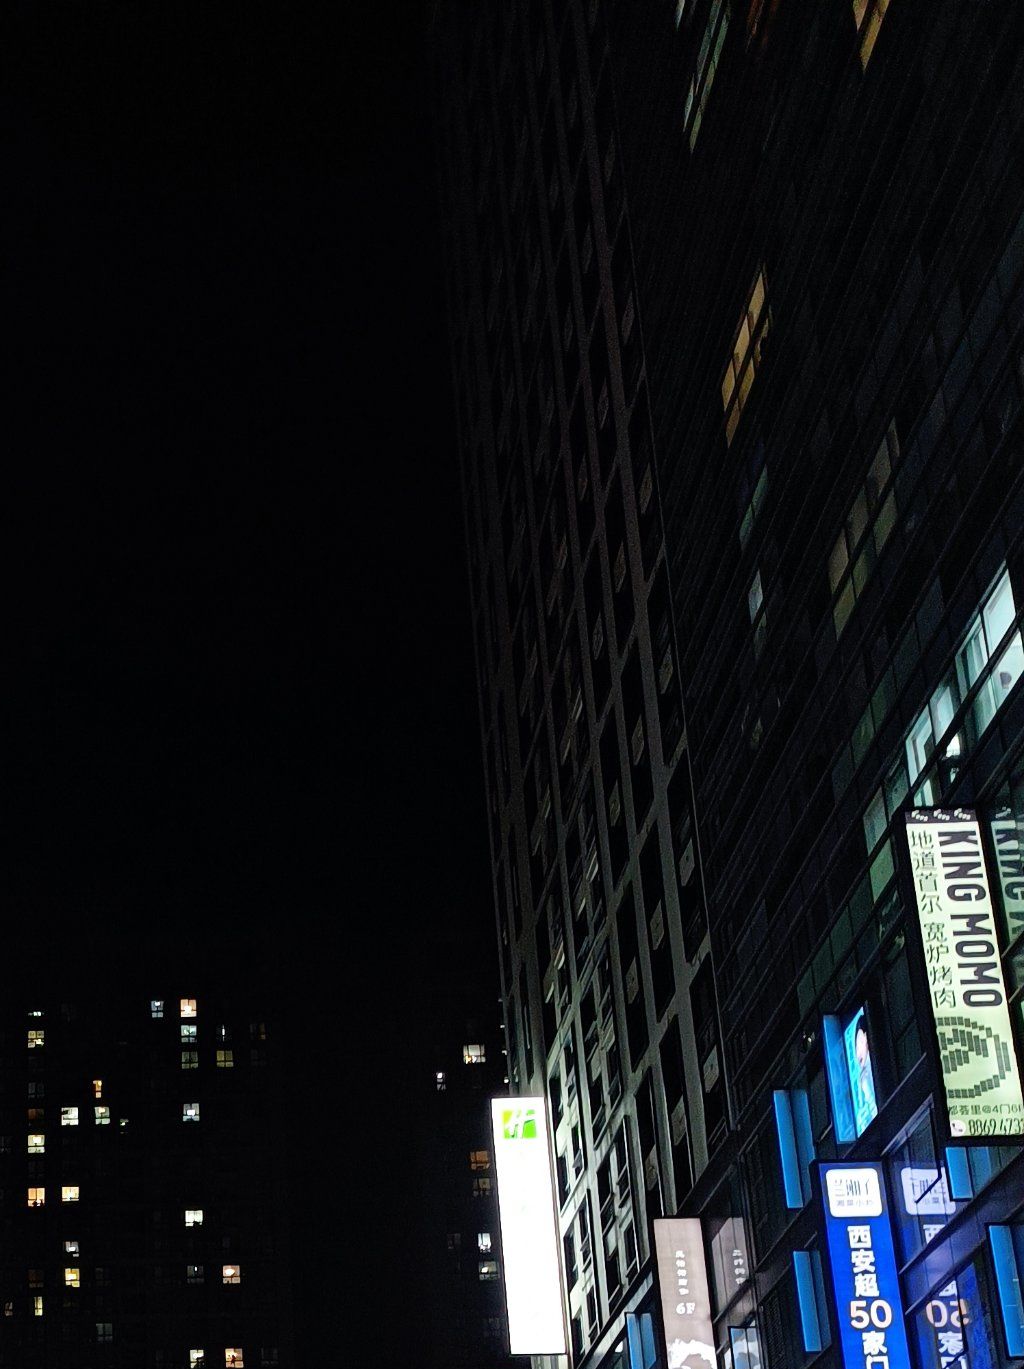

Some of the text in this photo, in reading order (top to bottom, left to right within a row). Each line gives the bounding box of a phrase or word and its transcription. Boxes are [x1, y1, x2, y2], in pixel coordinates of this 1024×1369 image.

[937, 831, 986, 901] KING
[950, 913, 1003, 1008] MOMO
[676, 1302, 695, 1315] 6F
